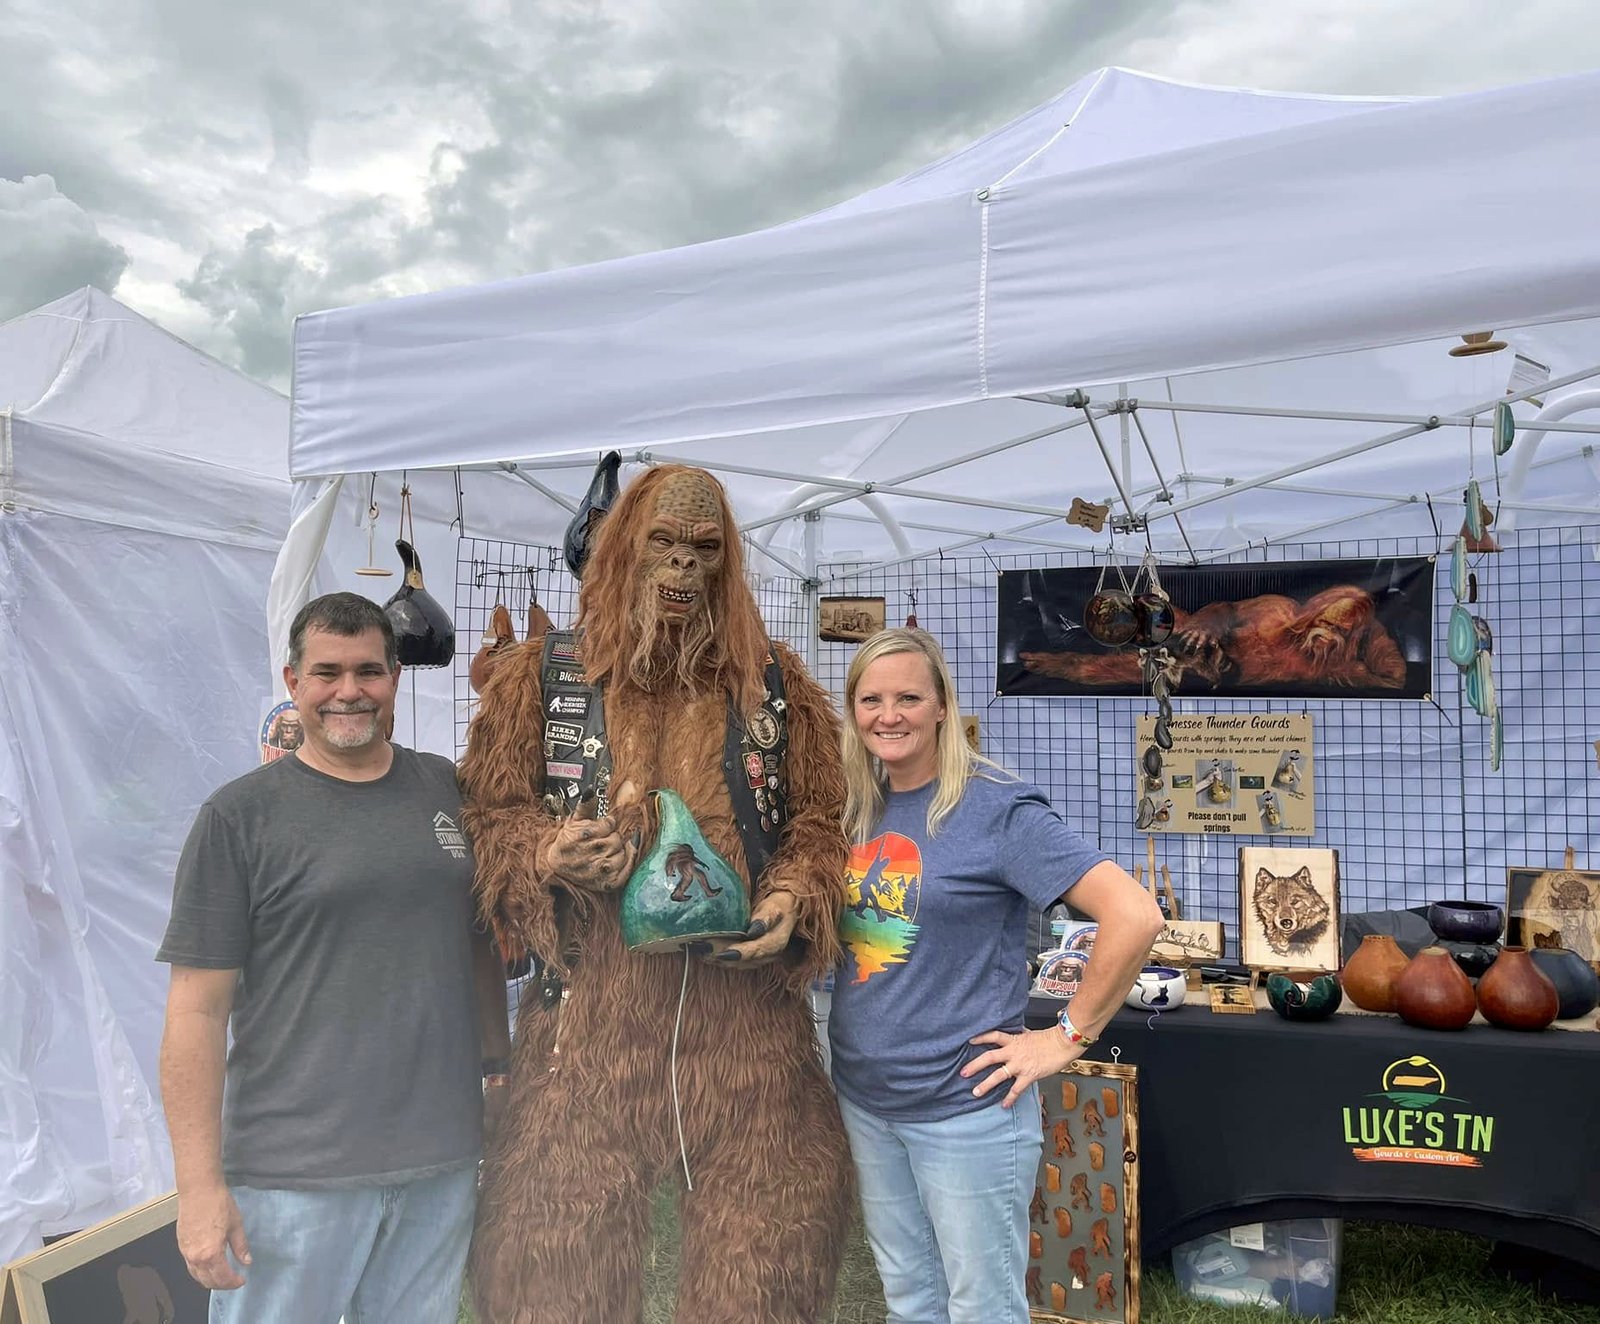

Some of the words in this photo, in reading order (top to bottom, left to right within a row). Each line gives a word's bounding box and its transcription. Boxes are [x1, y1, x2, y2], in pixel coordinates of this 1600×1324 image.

[559, 671, 587, 683] BIGFO
[1206, 715, 1246, 730] Thunder
[1251, 715, 1290, 729] Gourds
[551, 725, 576, 735] BIKER
[547, 731, 578, 742] GRANDPA
[1191, 734, 1202, 742] with
[1228, 734, 1242, 745] they
[1187, 812, 1212, 822] Please
[1212, 812, 1231, 822] don't
[1232, 813, 1247, 822] pull
[1203, 824, 1231, 833] springs
[1342, 1107, 1445, 1147] LUKE'S
[1452, 1113, 1494, 1152] TN
[1373, 1149, 1403, 1158] Gourds
[1414, 1152, 1443, 1160] Custom
